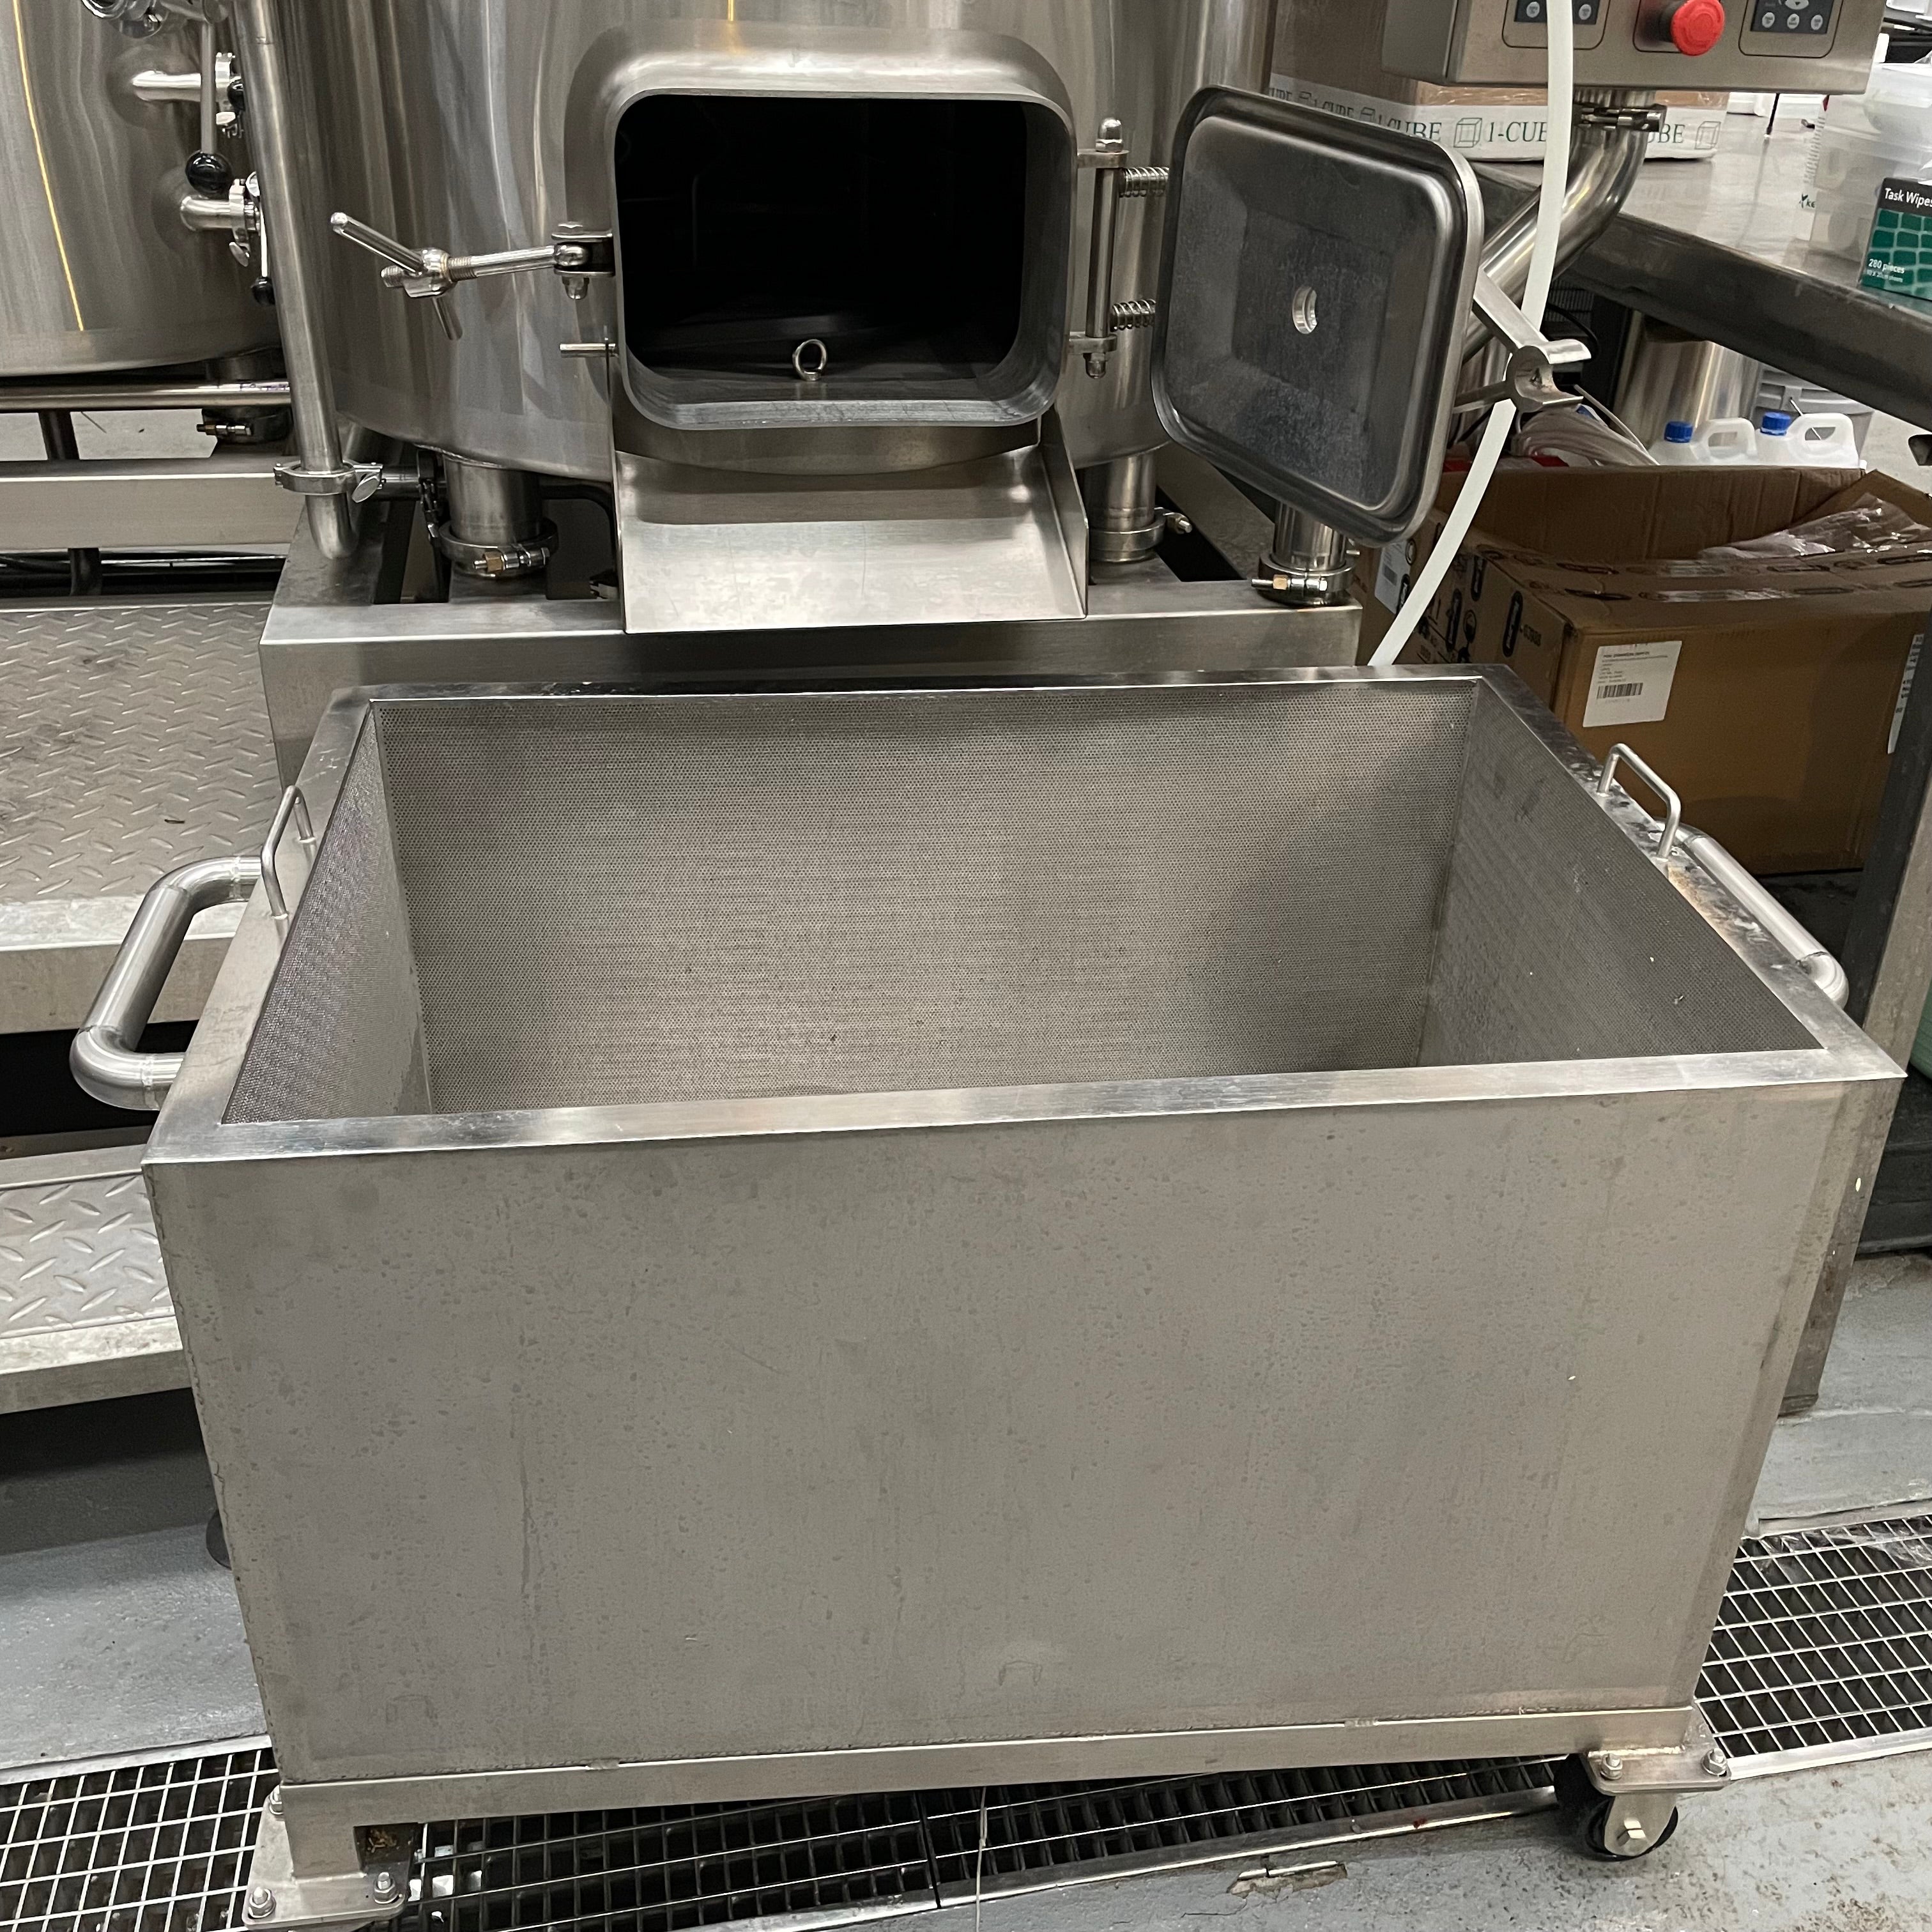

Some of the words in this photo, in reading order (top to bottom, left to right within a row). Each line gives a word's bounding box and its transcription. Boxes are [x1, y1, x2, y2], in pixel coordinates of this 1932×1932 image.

[1885, 187, 1905, 202] Task
[1868, 258, 1882, 269] 280
[1882, 262, 1905, 273] pieces
